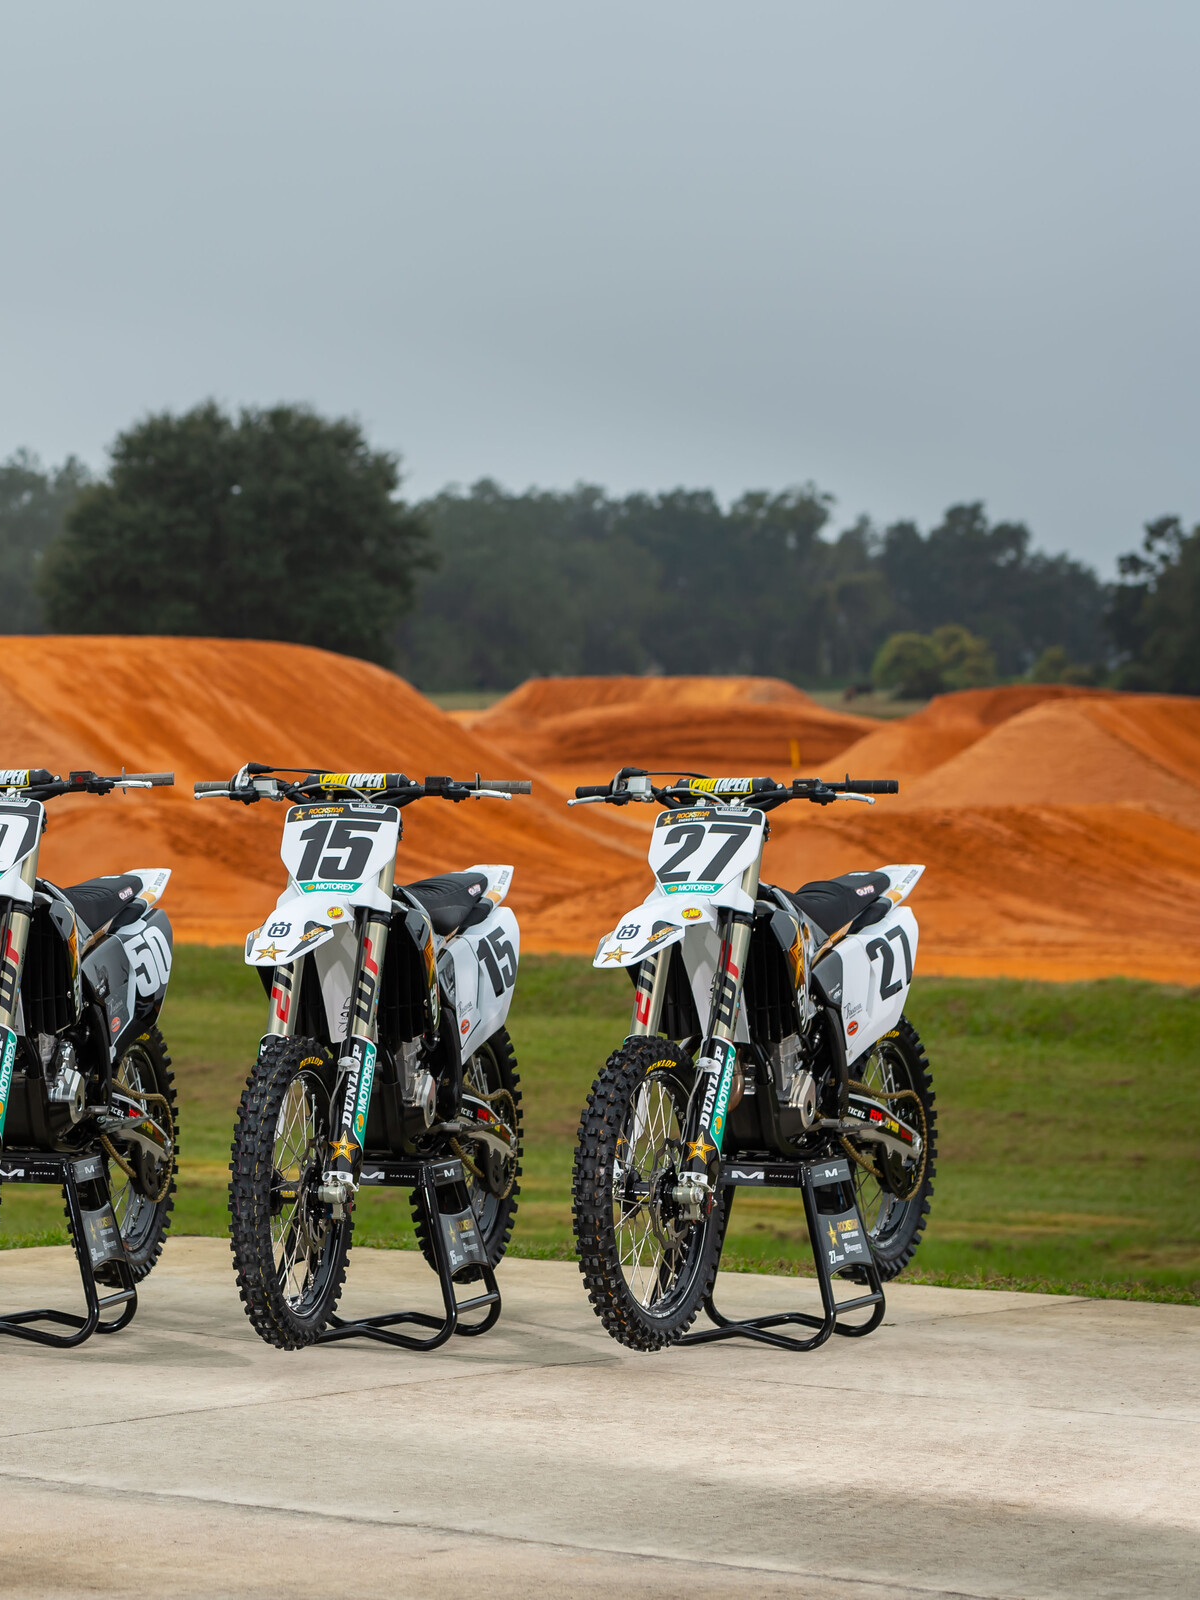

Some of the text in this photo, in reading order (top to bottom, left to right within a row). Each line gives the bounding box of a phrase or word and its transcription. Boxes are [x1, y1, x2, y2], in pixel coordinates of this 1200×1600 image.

[322, 773, 383, 788] PROTAPER
[692, 777, 751, 793] PROTAPER
[308, 807, 344, 815] ROCKSTAR
[676, 811, 710, 820] ROCKSTAR
[295, 820, 382, 881] 15
[656, 824, 752, 883] 27
[316, 883, 354, 891] MOTOREX
[678, 884, 715, 892] MOTOREX
[855, 884, 874, 897] GUTS
[124, 926, 172, 998] 50
[477, 926, 518, 998] 15
[866, 925, 913, 1001] 27
[299, 1056, 324, 1070] DUNLOP
[645, 1059, 677, 1076] DUNLOP
[342, 1044, 364, 1128] DUNLP
[357, 1050, 376, 1114] MOTOREX
[700, 1045, 724, 1130] DUNLP
[716, 1053, 736, 1117] MOTOREX
[869, 1108, 883, 1121] RK
[828, 1250, 837, 1265] 27
